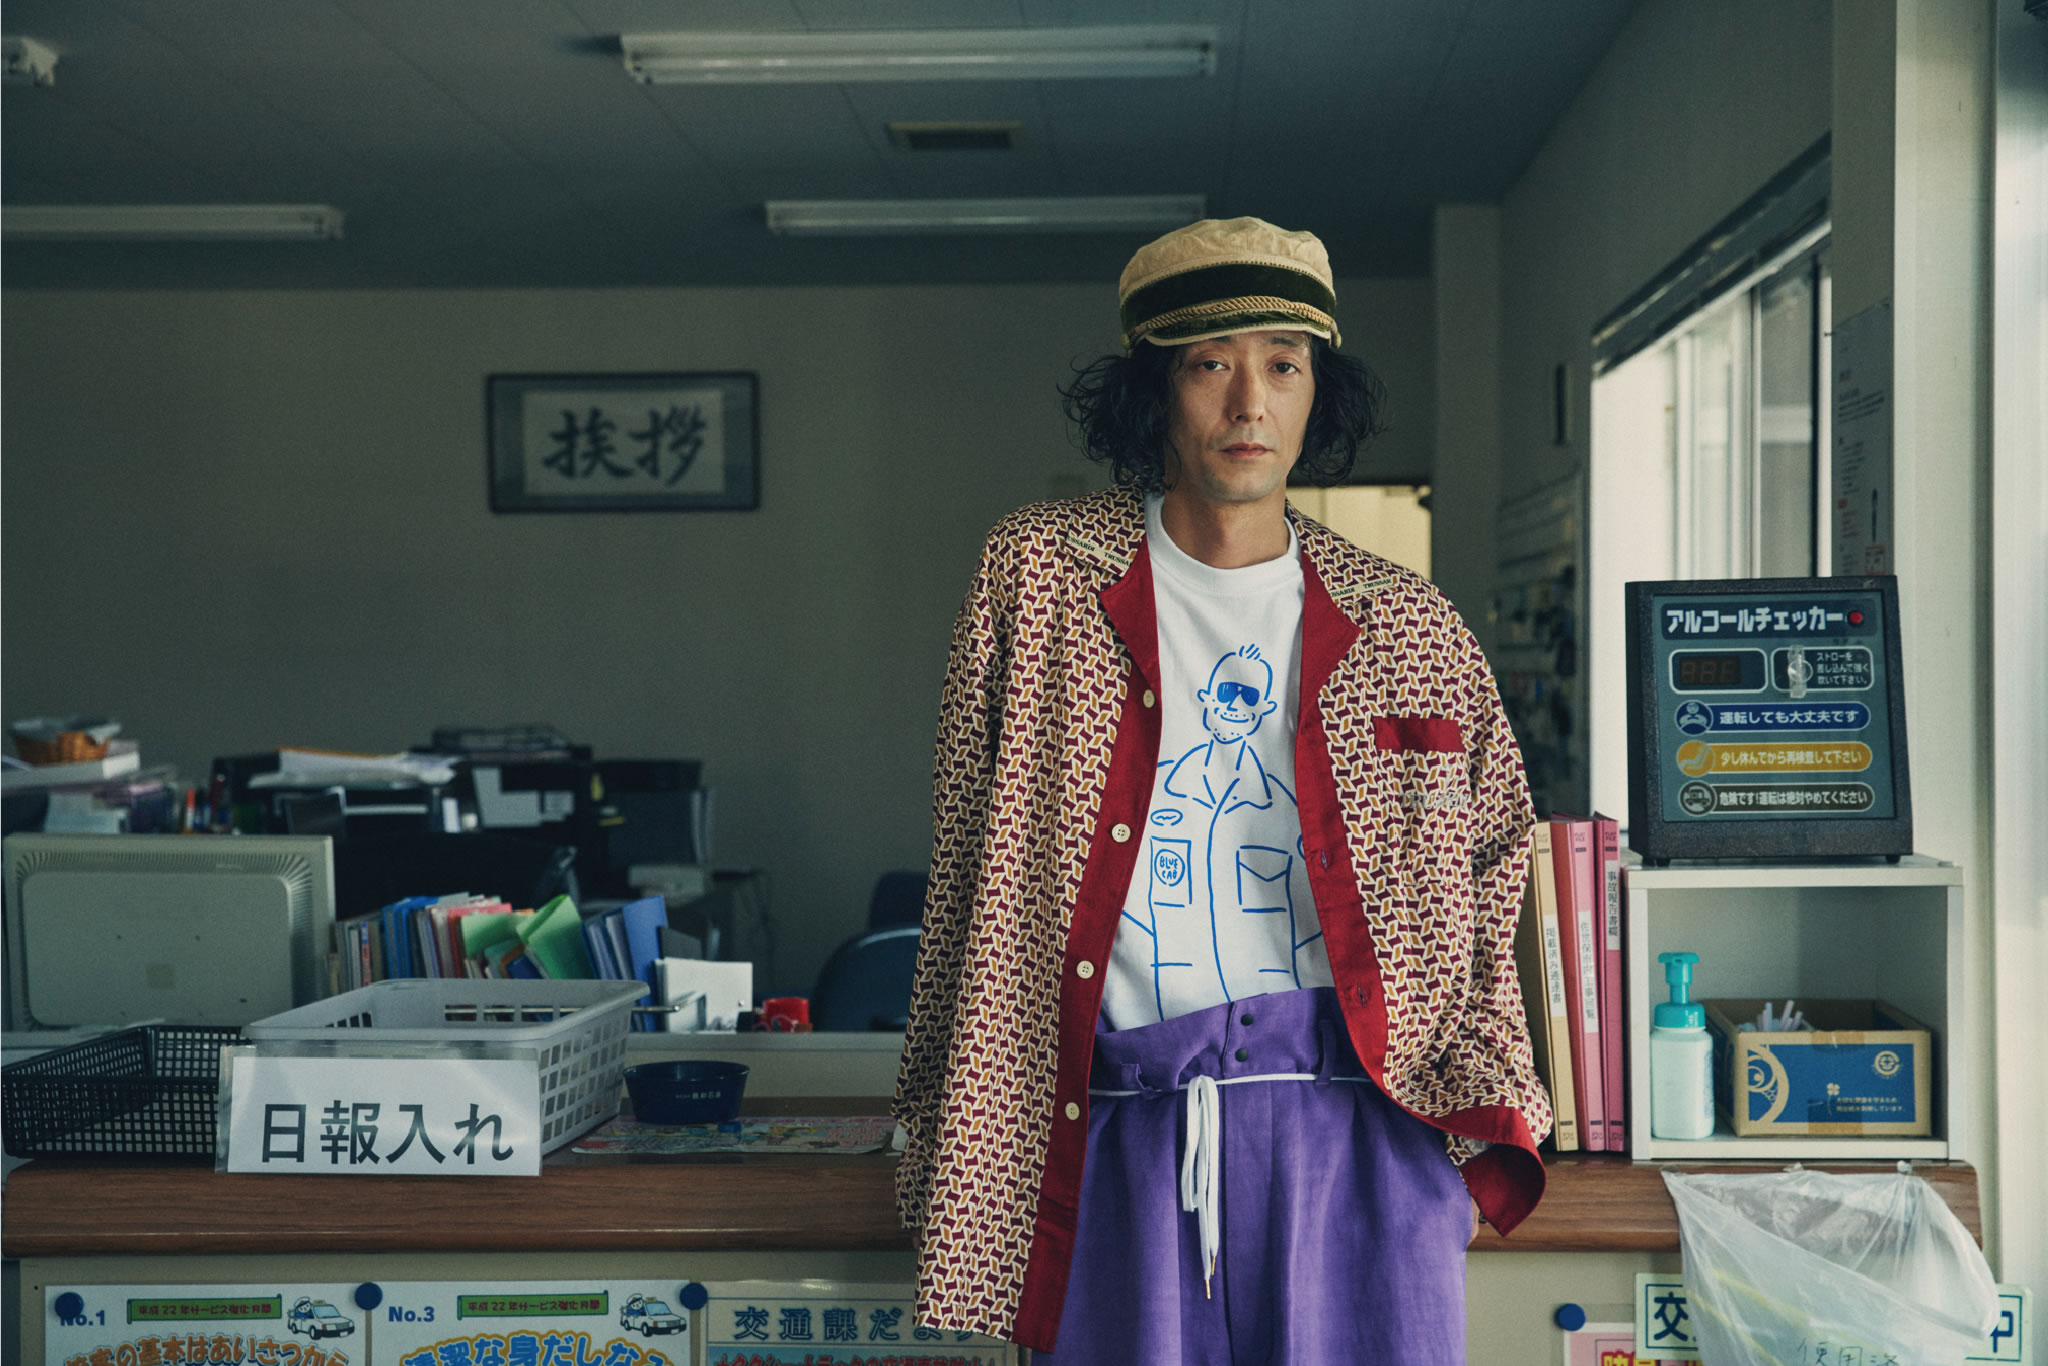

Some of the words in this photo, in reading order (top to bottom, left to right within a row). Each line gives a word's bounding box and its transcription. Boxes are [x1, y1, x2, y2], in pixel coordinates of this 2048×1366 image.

[543, 405, 707, 487] 挨拶
[1666, 606, 1844, 634] アルコールチェッカー
[1817, 652, 1853, 662] ストローを
[1817, 663, 1869, 674] 差し込んで強く
[1817, 675, 1868, 685] 吹いて下さい。
[1720, 710, 1860, 725] 運転しても大丈夫です
[1721, 751, 1862, 767] 少し休んでから再検査して下さい
[1160, 855, 1178, 869] BLUE
[1162, 869, 1177, 880] CAB
[262, 1100, 514, 1165] 日報入れ
[388, 1306, 435, 1322] No.3
[735, 1307, 974, 1341] 交通課だ
